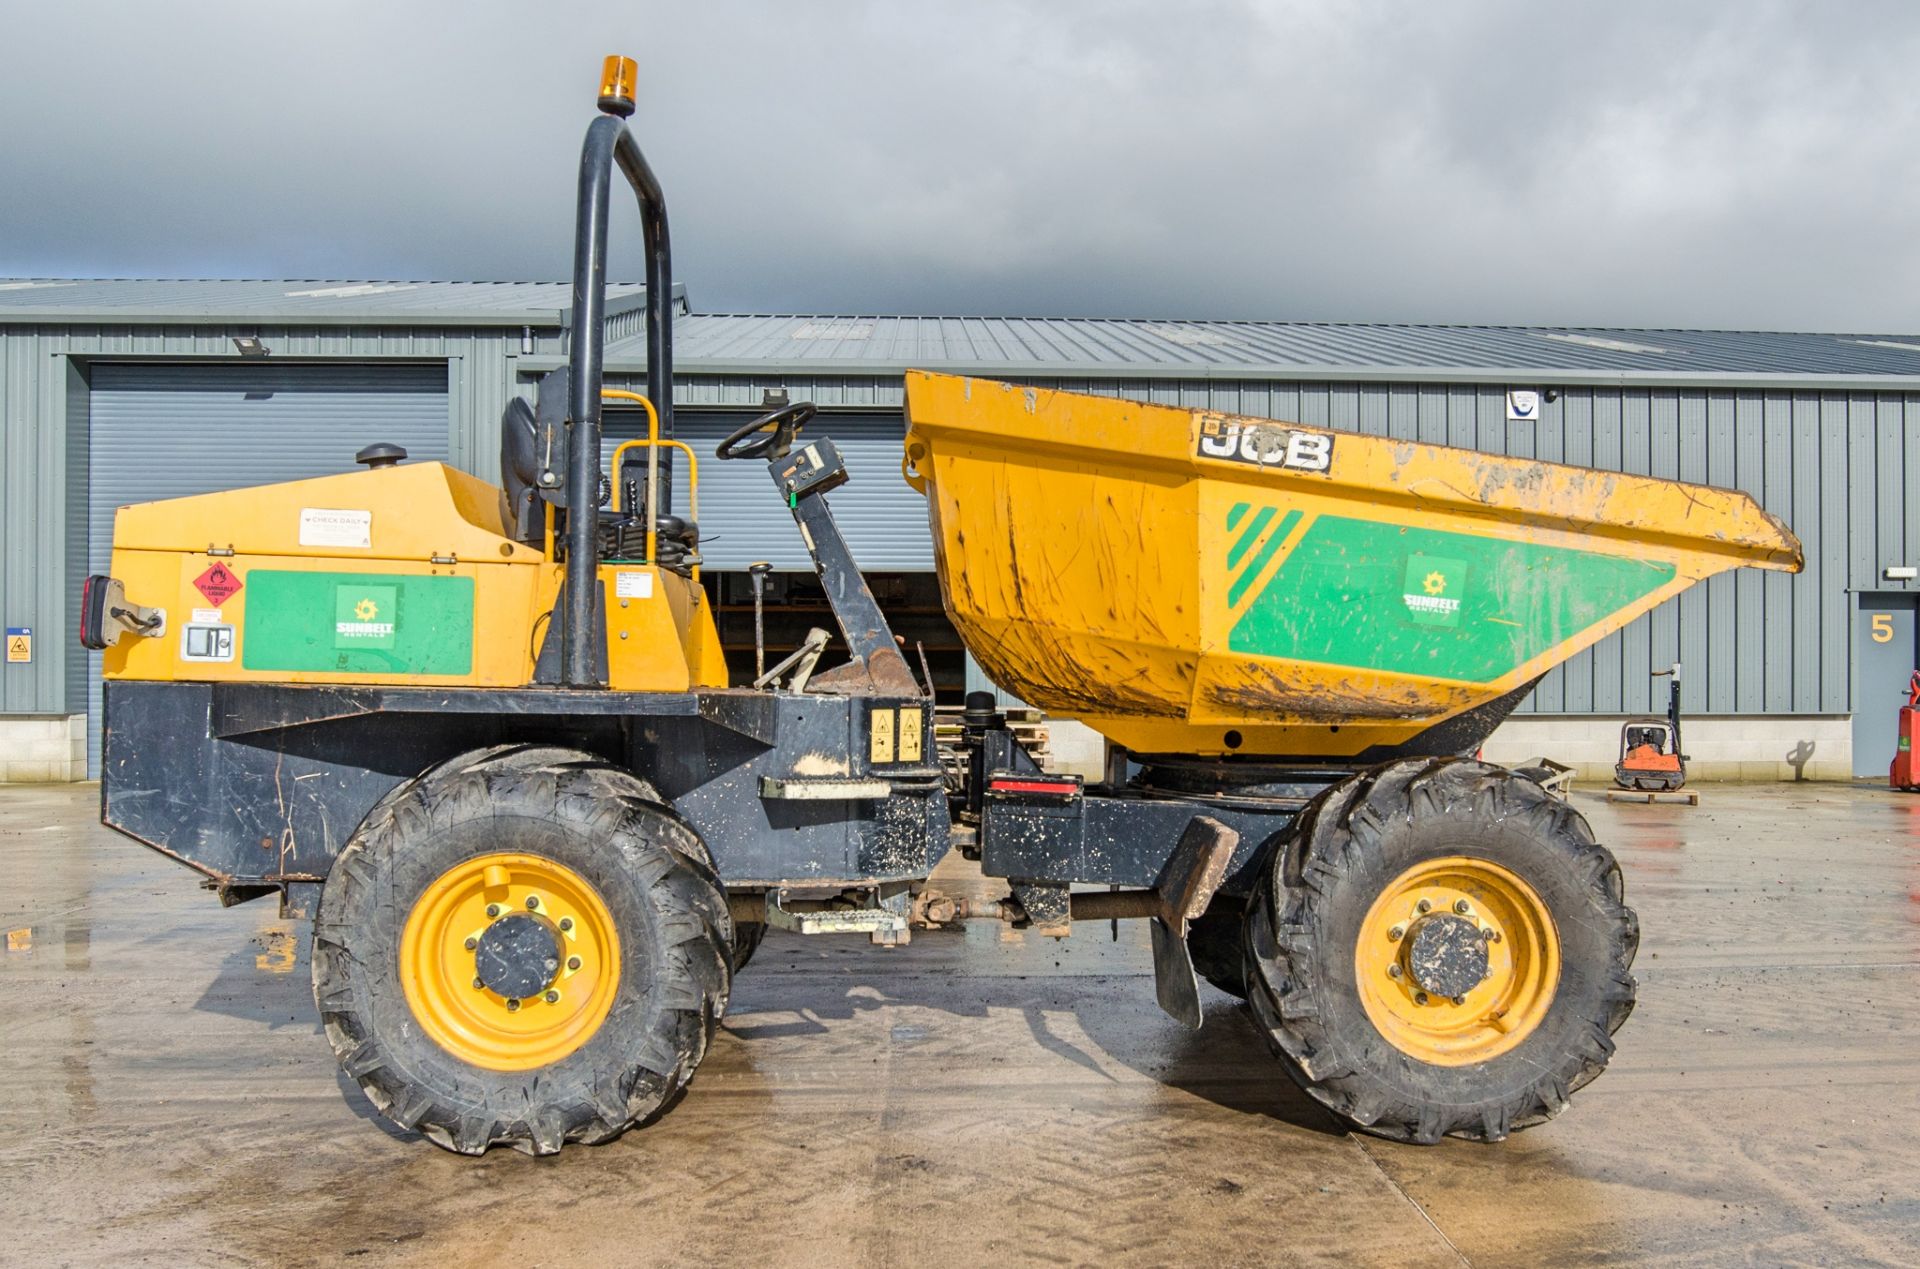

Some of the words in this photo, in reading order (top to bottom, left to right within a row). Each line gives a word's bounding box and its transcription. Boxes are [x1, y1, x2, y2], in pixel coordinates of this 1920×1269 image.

[312, 516, 338, 524] CHECK
[339, 517, 361, 525] DAILY
[201, 584, 234, 592] FLAMMABLE
[1403, 594, 1460, 610] SUNBELT
[1408, 605, 1450, 614] RENTALS
[336, 622, 394, 633] SUNBELT
[1871, 614, 1894, 643] 5
